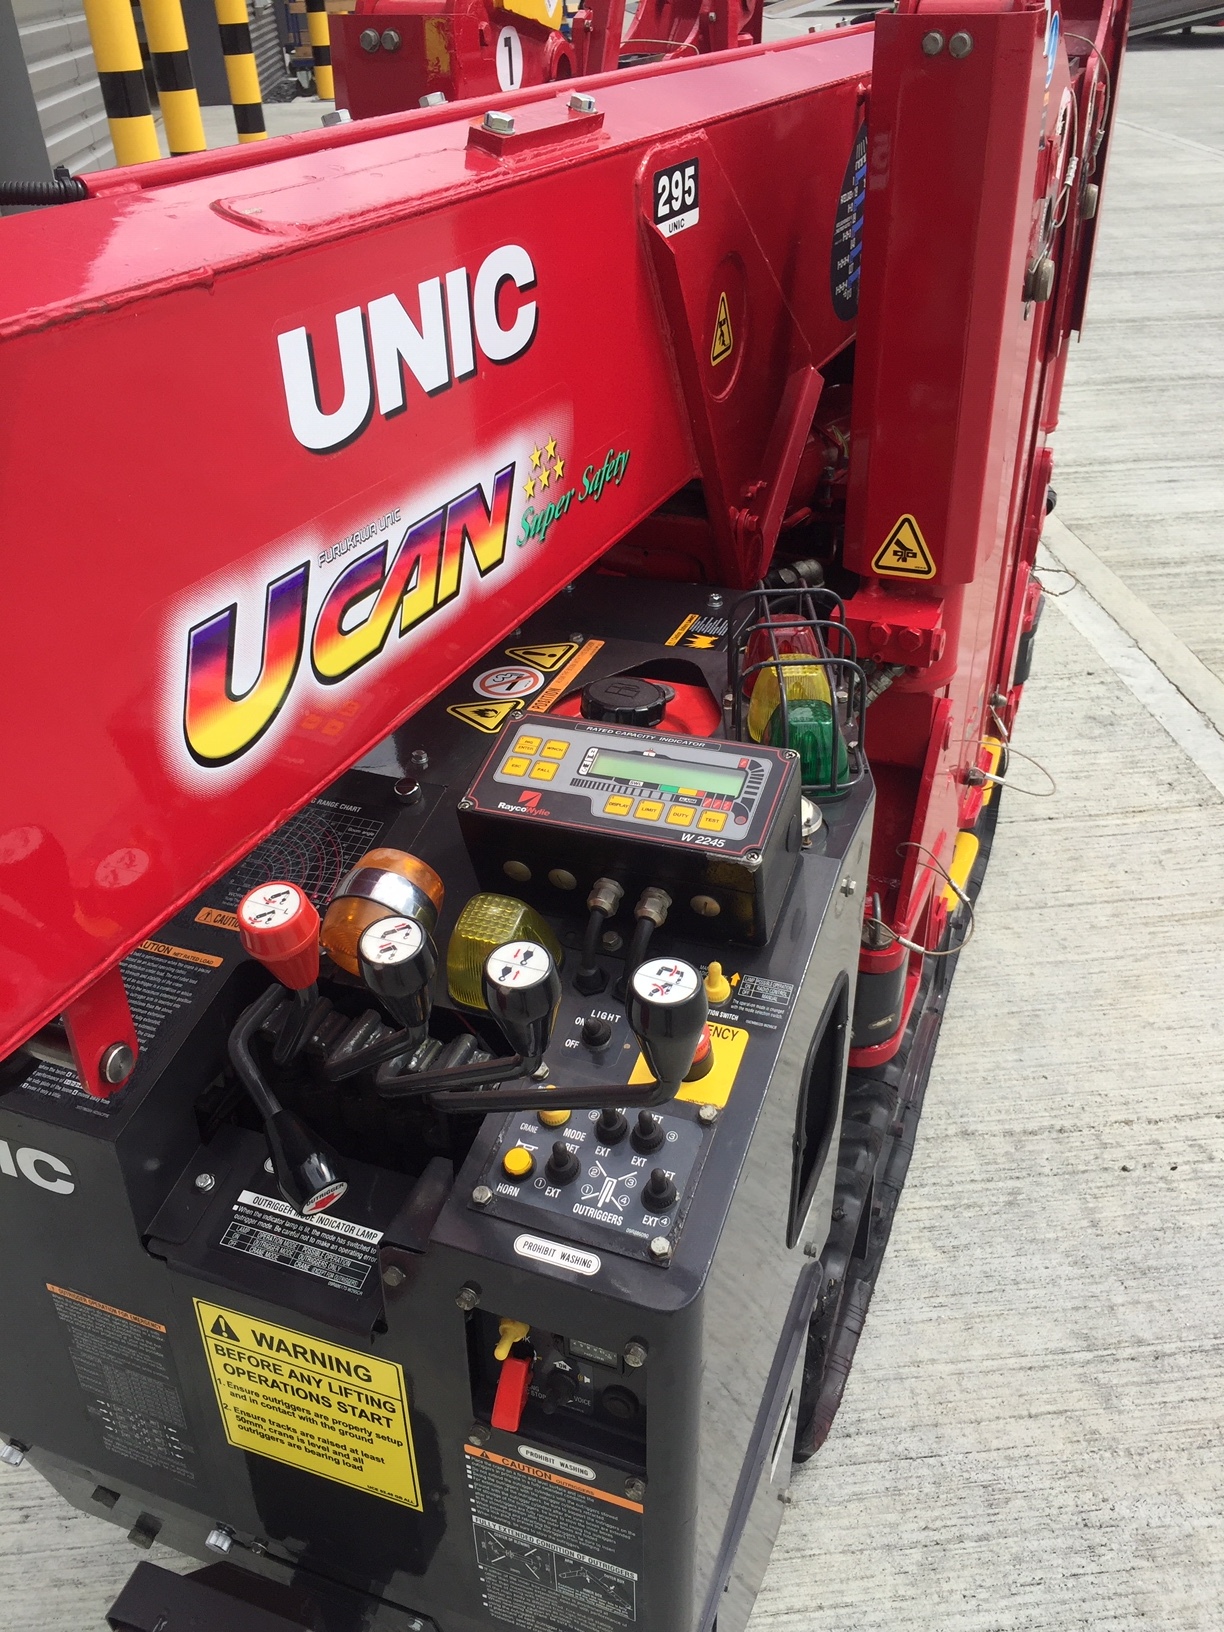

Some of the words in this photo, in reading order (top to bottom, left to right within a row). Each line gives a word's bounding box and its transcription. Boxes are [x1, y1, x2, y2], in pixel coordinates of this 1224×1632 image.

[504, 36, 514, 86] 1
[658, 165, 695, 217] 295
[668, 218, 685, 233] UNIC
[277, 245, 537, 452] UNIC
[516, 489, 574, 548] Super
[577, 447, 631, 501] Safety
[318, 522, 377, 568] FURUKAWA
[379, 508, 401, 531] UNIC
[183, 461, 516, 768] UCAN
[586, 726, 614, 735] RATED
[614, 730, 656, 740] CAPACITY
[658, 736, 706, 747] INDICATOR
[317, 798, 339, 808] RANGE
[339, 803, 362, 813] CHART
[608, 801, 629, 809] DISPLAY
[641, 806, 657, 814] LIMIT
[672, 811, 689, 819] DUTY
[705, 816, 720, 824] TEST
[361, 830, 375, 838] angle
[681, 833, 690, 842] W
[694, 836, 726, 847] 2245
[183, 953, 200, 961] RATED
[200, 957, 214, 965] LOAD
[591, 1009, 621, 1023] LIGHT
[719, 1011, 739, 1021] SWITCH
[564, 1038, 580, 1048] OFF
[520, 1122, 538, 1133] CRANE
[562, 1127, 587, 1142] MODE
[595, 1145, 611, 1157] EXT
[631, 1155, 647, 1168] EXT
[306, 1182, 344, 1206] OUTRIGGER
[496, 1182, 520, 1197] HORN
[545, 1186, 561, 1199] EXT
[252, 1196, 293, 1214] OUTRIGGER
[316, 1216, 355, 1234] INDICATOR
[356, 1228, 377, 1241] LAMP
[572, 1203, 624, 1226] OUTRIGGERS
[642, 1214, 659, 1227] EXT
[233, 1214, 256, 1225] outrigger
[281, 1229, 299, 1238] careful
[315, 1239, 330, 1247] make
[337, 1246, 363, 1259] operating
[236, 1226, 249, 1234] LAMP
[238, 1206, 253, 1215] When
[262, 1214, 284, 1225] indicator
[284, 1221, 298, 1230] lamp
[320, 1232, 336, 1241] mode
[347, 1240, 370, 1251] switched
[253, 1240, 279, 1252] OUTRIGGER
[279, 1248, 293, 1256] MODE
[256, 1232, 283, 1245] OPERATION
[283, 1241, 297, 1249] MODE
[249, 1247, 264, 1256] CRANE
[264, 1251, 278, 1260] MODE
[301, 1247, 324, 1258] POSSIBLE
[324, 1254, 350, 1266] OPERATION
[522, 1240, 556, 1257] PROHIBIT
[559, 1251, 593, 1269] WASHING
[293, 1261, 309, 1271] CRANE
[297, 1254, 327, 1268] OUTRIGGERS
[327, 1263, 341, 1272] ONLY
[252, 1331, 371, 1381] WARNING
[214, 1344, 283, 1375] BEFORE
[288, 1369, 322, 1388] ANY
[328, 1382, 395, 1413] LIFTING
[224, 1363, 331, 1407] OPERATIONS
[337, 1401, 392, 1427] START
[530, 1390, 547, 1400] STOP
[574, 1396, 591, 1406] VOICE
[226, 1381, 259, 1397] Ensure
[262, 1395, 311, 1415] outriggers
[314, 1412, 329, 1421] are
[332, 1418, 372, 1437] properly
[375, 1433, 403, 1446] setup
[229, 1391, 247, 1401] and
[249, 1396, 258, 1405] in
[260, 1402, 295, 1417] contact
[298, 1414, 318, 1425] with
[320, 1421, 335, 1431] the
[338, 1428, 373, 1444] ground
[233, 1406, 266, 1422] Ensure
[268, 1419, 297, 1433] tracks
[300, 1430, 315, 1439] are
[317, 1437, 346, 1450] raised
[349, 1447, 359, 1455] at
[361, 1450, 384, 1464] least
[235, 1415, 266, 1431] 50mm,
[268, 1427, 294, 1440] crane
[296, 1436, 305, 1444] is
[307, 1439, 329, 1452] level
[332, 1449, 350, 1459] and
[352, 1456, 364, 1464] all
[238, 1424, 284, 1444] outriggers
[287, 1441, 302, 1450] are
[304, 1446, 340, 1465] bearing
[342, 1459, 363, 1471] load
[525, 1450, 555, 1464] PROHIBIT
[559, 1461, 589, 1476] WASHING
[502, 1458, 552, 1480] CAUTION
[555, 1479, 595, 1495] OUTRIGGERS
[475, 1517, 496, 1528] FULLY
[498, 1525, 533, 1541] EXTENDED
[536, 1539, 574, 1556] CONDITION
[576, 1553, 586, 1561] OF
[588, 1557, 635, 1579] OUTRIGGERS
